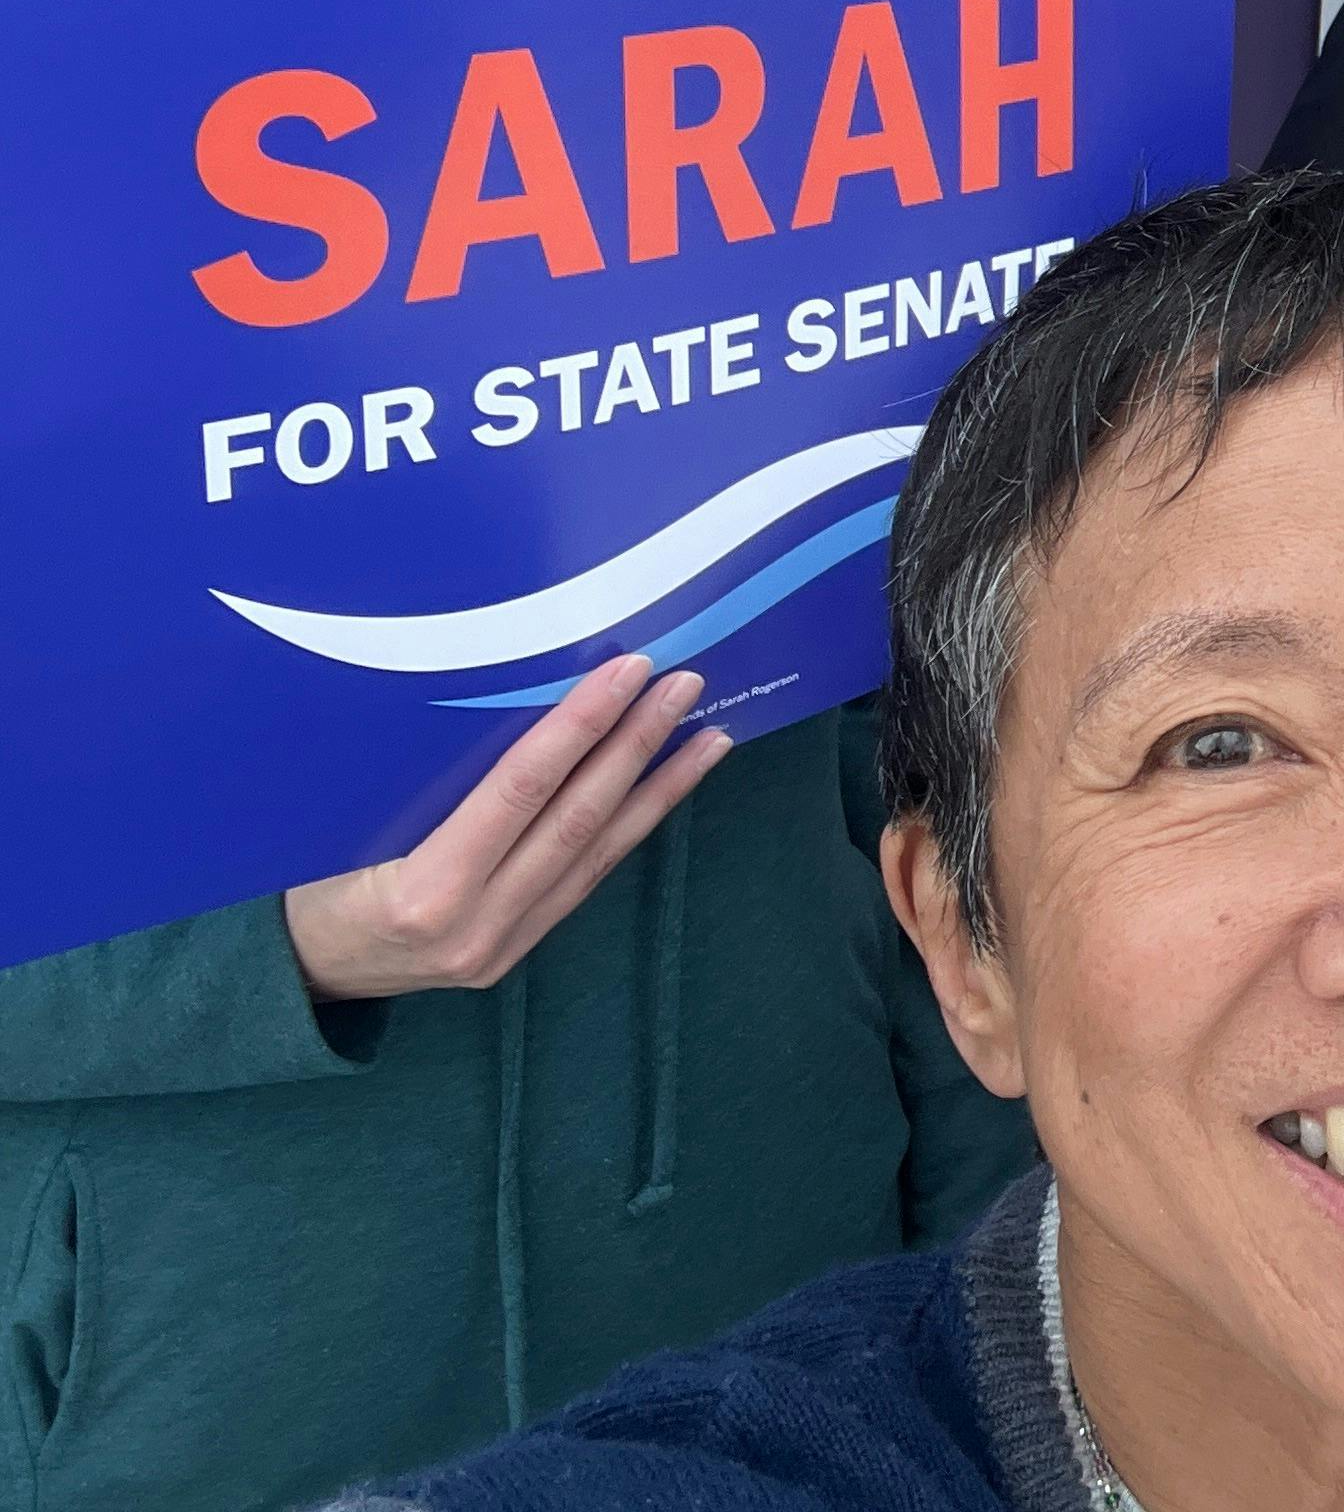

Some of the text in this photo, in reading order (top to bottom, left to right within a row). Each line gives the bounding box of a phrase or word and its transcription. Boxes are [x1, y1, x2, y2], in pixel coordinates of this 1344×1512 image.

[202, 385, 438, 504] FOR
[470, 312, 763, 448] STATE
[680, 673, 799, 725] ends of Sarah Rogerson
